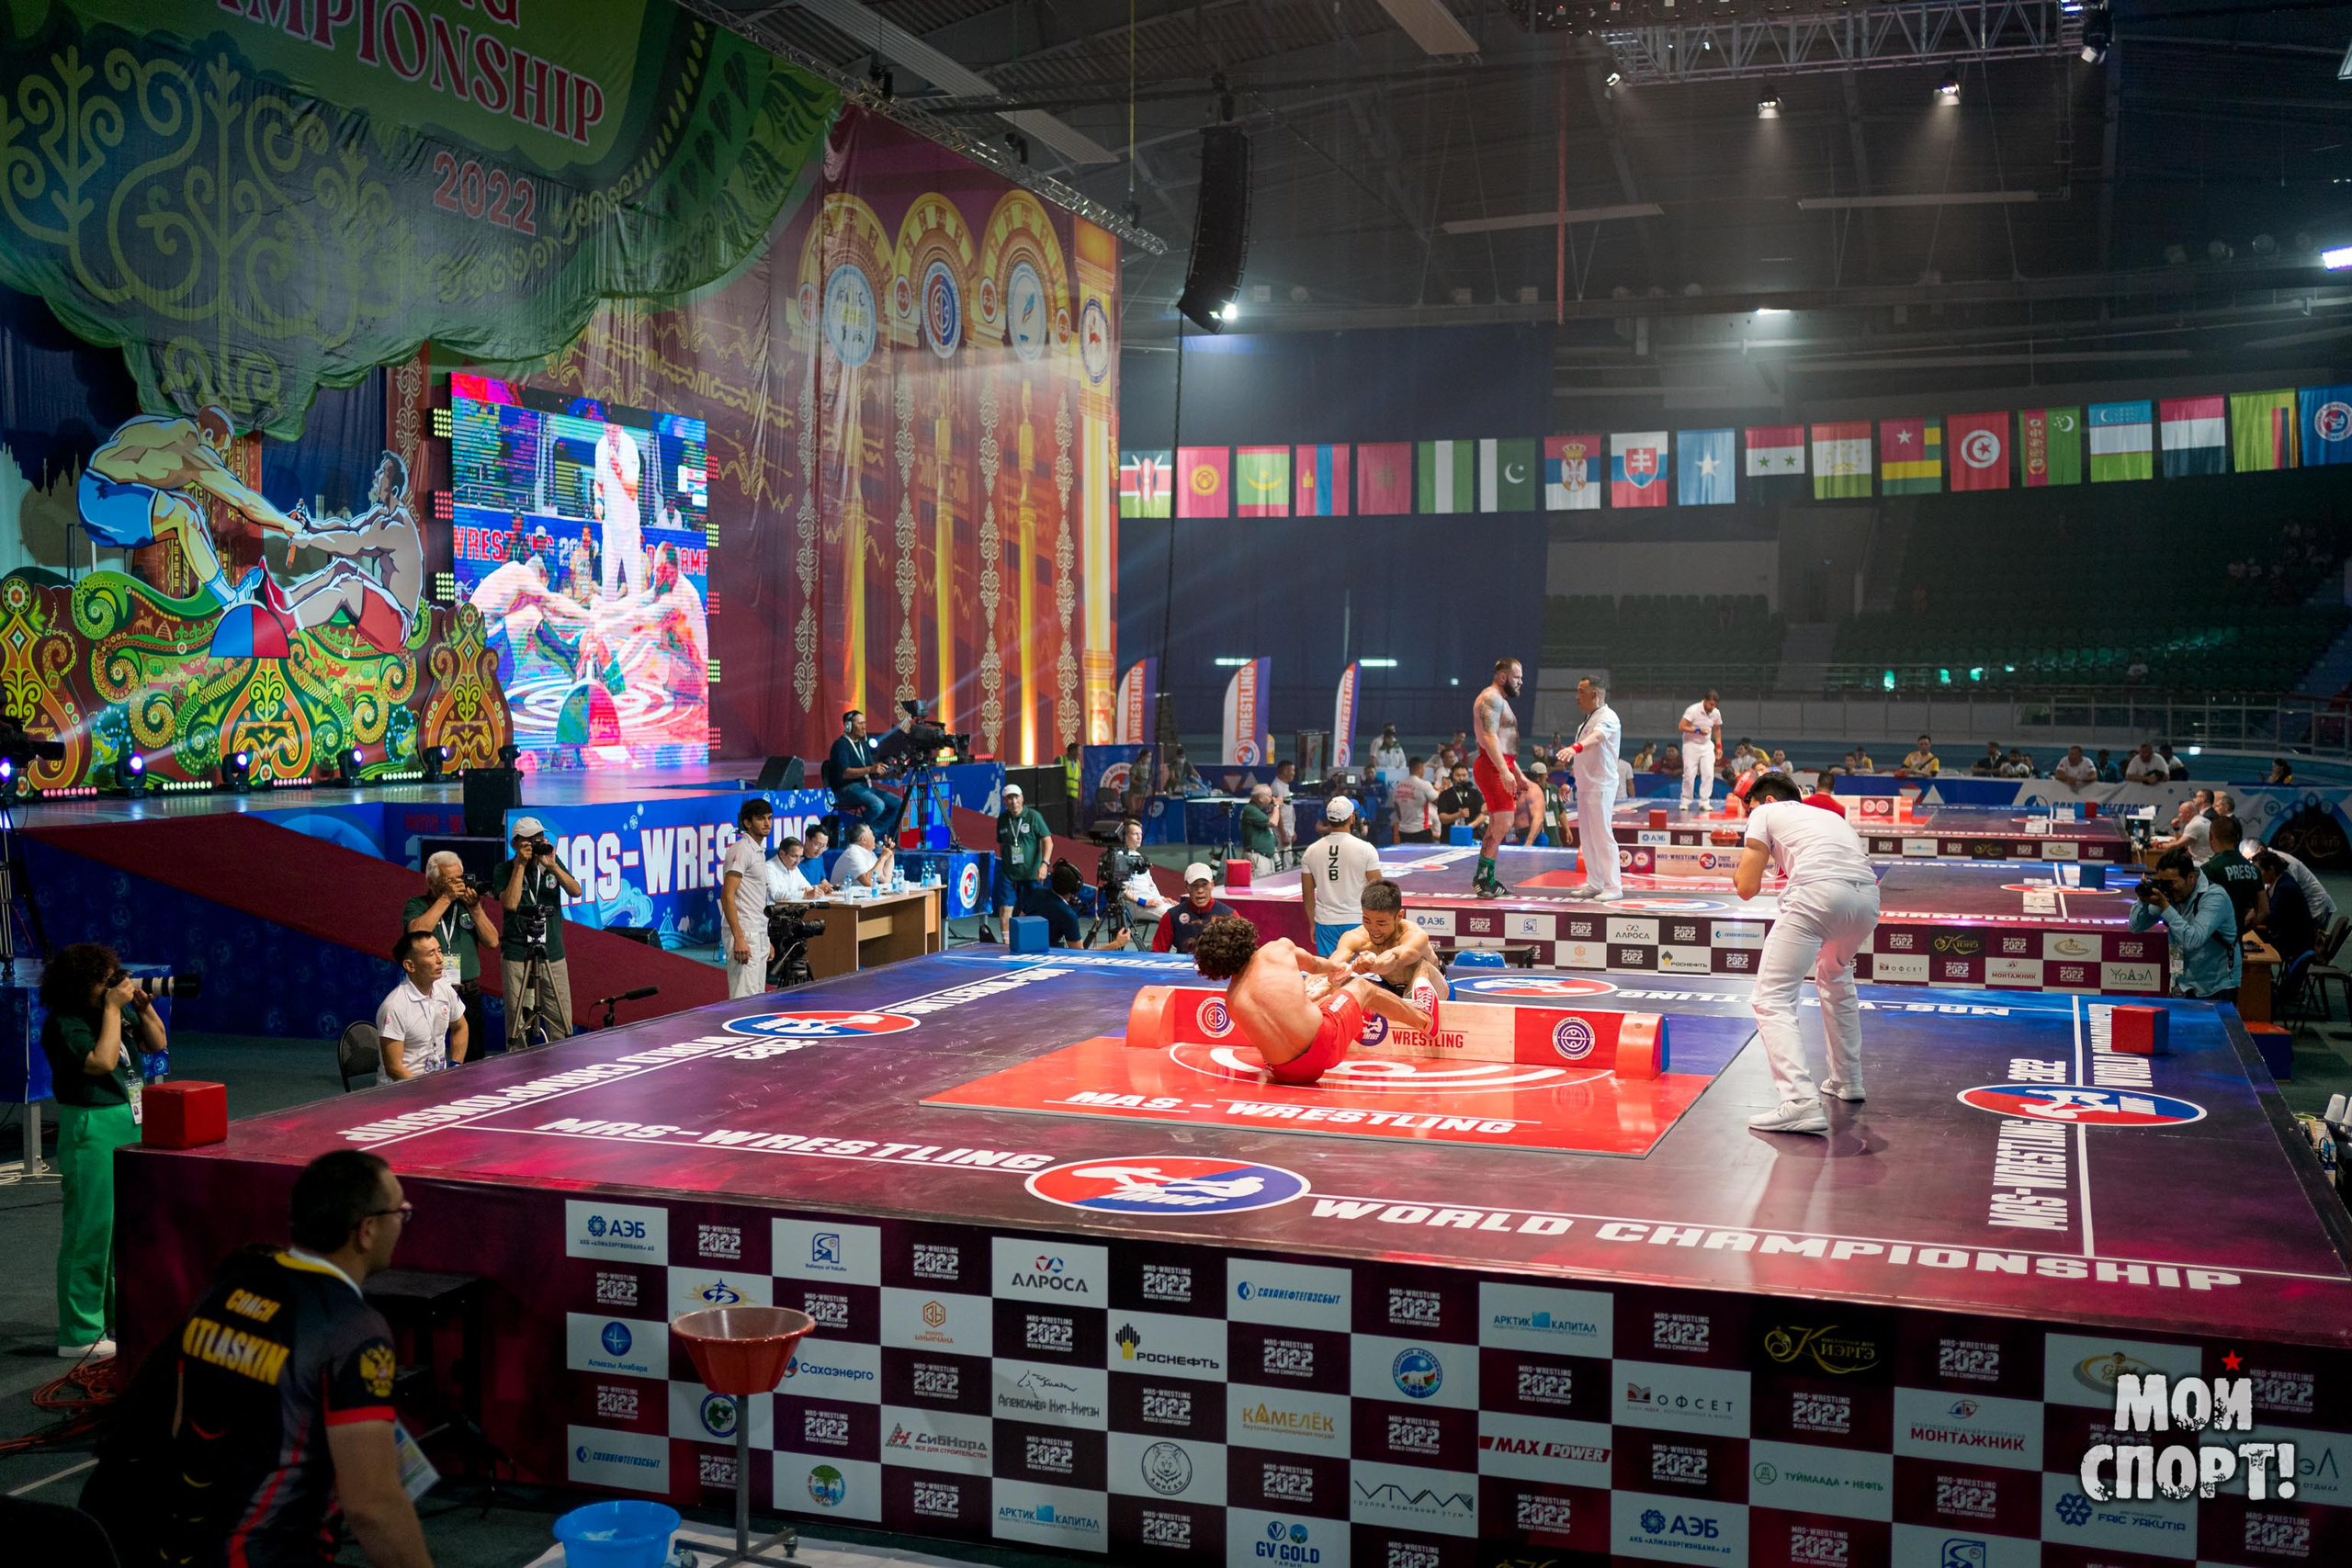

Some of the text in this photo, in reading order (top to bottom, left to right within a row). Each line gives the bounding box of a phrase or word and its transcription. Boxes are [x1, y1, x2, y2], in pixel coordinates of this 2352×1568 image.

[218, 0, 604, 145] MPIONSHIP
[433, 152, 537, 235] 2022
[1238, 666, 1254, 740] WRESTLING
[404, 812, 466, 833] MAS-W
[1651, 834, 1666, 842] АЭБ
[1329, 845, 1339, 881] UZB
[2225, 865, 2258, 881] PRESS
[1427, 916, 1445, 926] АЭБ
[1470, 920, 1490, 931] 2022
[1570, 924, 1591, 934] 2022
[1674, 928, 1695, 938] 2022
[1890, 937, 1913, 947] 2022
[2003, 941, 2027, 951] 2022
[2119, 945, 2143, 955] 2022
[1622, 952, 1643, 963] 2022
[1726, 955, 1747, 966] 2022
[1946, 965, 1969, 976] 2022
[1992, 972, 2036, 980] МОНТАЖНИК
[2060, 969, 2084, 980] 2022
[536, 1117, 1056, 1169] MAS-WRESTLING
[609, 1220, 646, 1239] АЭБ
[698, 1232, 741, 1251] 2022
[1310, 1199, 2242, 1291] WORLD CHAMPIONSHIP
[914, 1251, 958, 1271] 2022
[597, 1280, 638, 1298] 2022
[1011, 1272, 1089, 1292] АЛРОСА
[1143, 1272, 1191, 1293] 2022
[224, 1287, 282, 1323] COACH
[1257, 1286, 1341, 1305] САХАНЕФТЕГАЗСБЫТ
[805, 1301, 848, 1321] 2022
[1389, 1296, 1441, 1318] 2022
[1027, 1323, 1072, 1344] 2022
[1493, 1314, 1531, 1327] АРКТИК
[1551, 1319, 1598, 1333] КАПИТАЛ
[1655, 1321, 1709, 1343] 2022
[588, 1359, 648, 1372] Алмазы Анабара
[1136, 1351, 1219, 1369] РОСНЕФТЬ
[1264, 1347, 1313, 1369] 2022
[1939, 1348, 1999, 1371] 2022
[800, 1361, 874, 1381] Сахаэнерго
[914, 1371, 958, 1391] 2022
[1518, 1373, 1571, 1395] 2022
[597, 1393, 638, 1412] 2022
[1143, 1395, 1191, 1416] 2022
[1657, 1394, 1734, 1413] ОФСЕТ
[1793, 1401, 1850, 1424] 2022
[805, 1417, 849, 1438] 2022
[1388, 1423, 1440, 1445] 2022
[1495, 1437, 1606, 1462] MAX POWER
[1911, 1427, 2025, 1451] МОНТАЖНИК
[592, 1450, 662, 1469] САХАНЕФТЕГАЗСБЫТ
[1026, 1443, 1072, 1465] 2022
[1653, 1452, 1707, 1475] 2022
[1263, 1472, 1312, 1493] 2022
[1784, 1471, 1883, 1492] ТУЙМААДА НЕФТЬ
[914, 1489, 958, 1509] 2022
[1937, 1484, 1996, 1509] 2022
[999, 1506, 1035, 1520] АРКТИК
[1055, 1514, 1100, 1529] КАПИТАЛ
[1518, 1502, 1570, 1524] 2022
[1143, 1518, 1191, 1540] 2022
[1669, 1514, 1719, 1539] АЭБ
[2245, 1521, 2310, 1547] 2022
[1629, 1535, 1643, 1543] АКБ
[1792, 1535, 1848, 1558] 2022
[1256, 1540, 1320, 1564] GV GOLD
